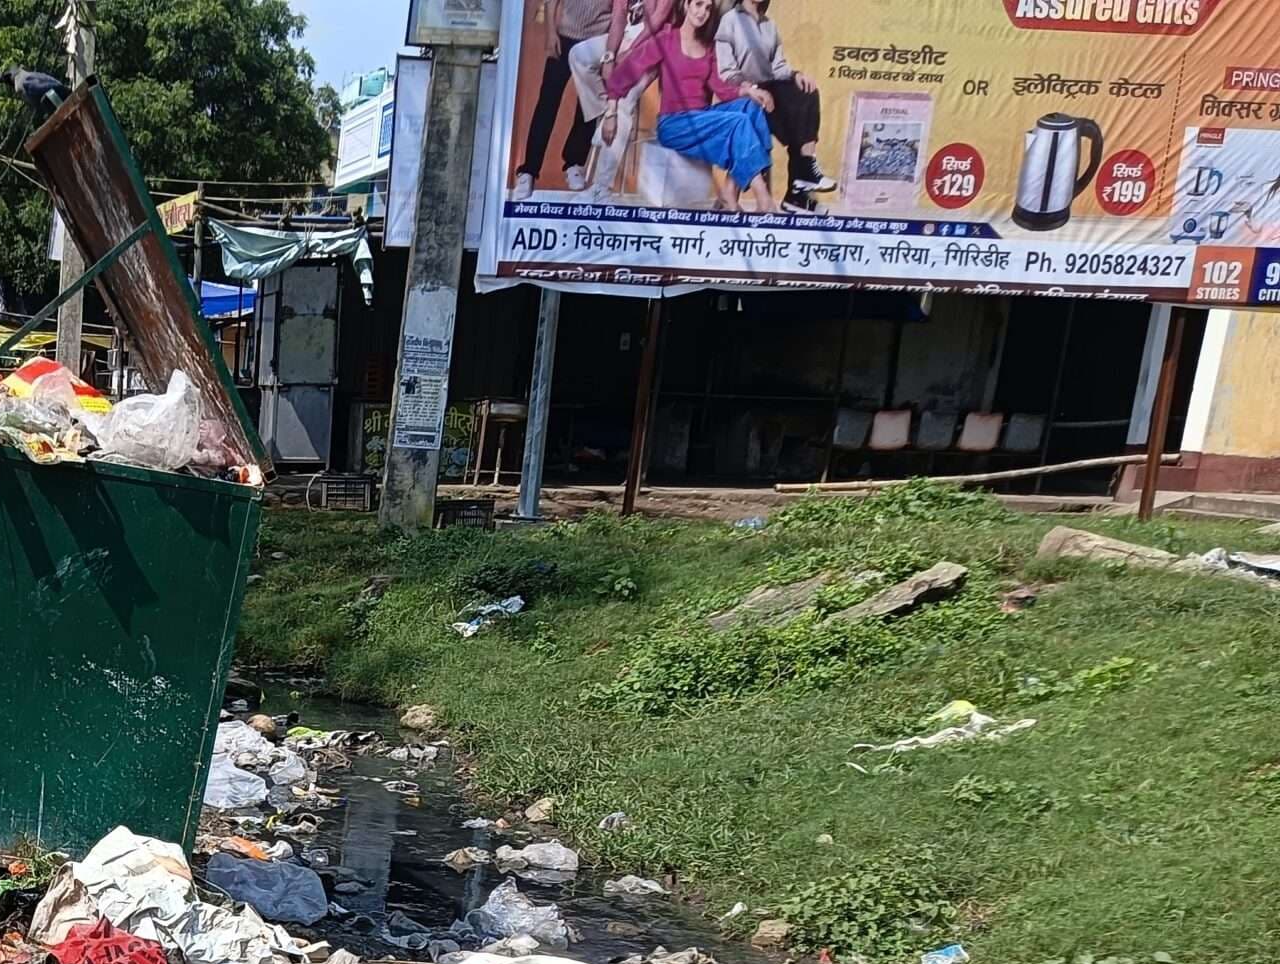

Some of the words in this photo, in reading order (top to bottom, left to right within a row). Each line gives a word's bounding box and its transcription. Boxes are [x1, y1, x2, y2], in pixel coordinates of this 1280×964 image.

[962, 80, 989, 96] OR
[1011, 73, 1103, 99] इलेक्ट्रिक
[1108, 77, 1165, 99] केटल
[1199, 94, 1266, 120] मिक्सर
[933, 174, 975, 197] ₹129
[1102, 180, 1146, 203] ₹199
[574, 225, 663, 254] विवेकानन्द
[945, 242, 1011, 270] गिरिडीह
[1024, 251, 1057, 274] Ph.
[1065, 253, 1186, 278] 9205824327
[1202, 261, 1242, 285] 102
[1195, 287, 1241, 300] STORES
